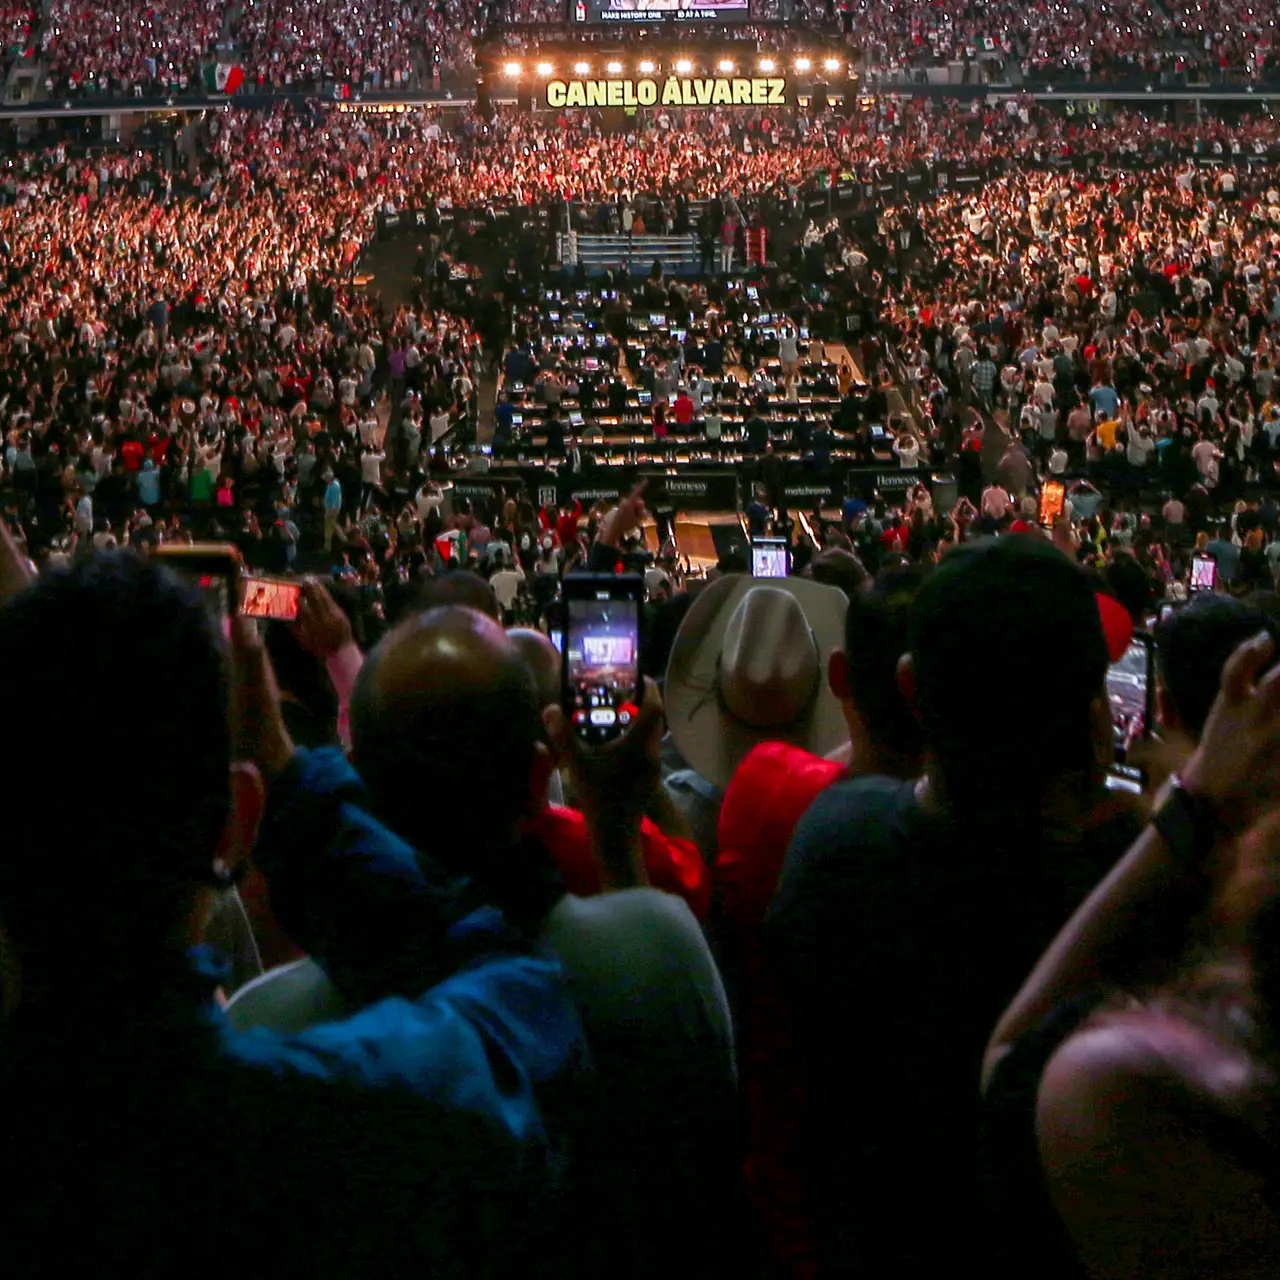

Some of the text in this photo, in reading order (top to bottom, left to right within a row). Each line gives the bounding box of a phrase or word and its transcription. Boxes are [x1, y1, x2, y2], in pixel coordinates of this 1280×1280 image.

[620, 11, 648, 20] HISTORY
[546, 75, 787, 107] CANELO ÁLVAREZ
[665, 480, 708, 491] Hennessy
